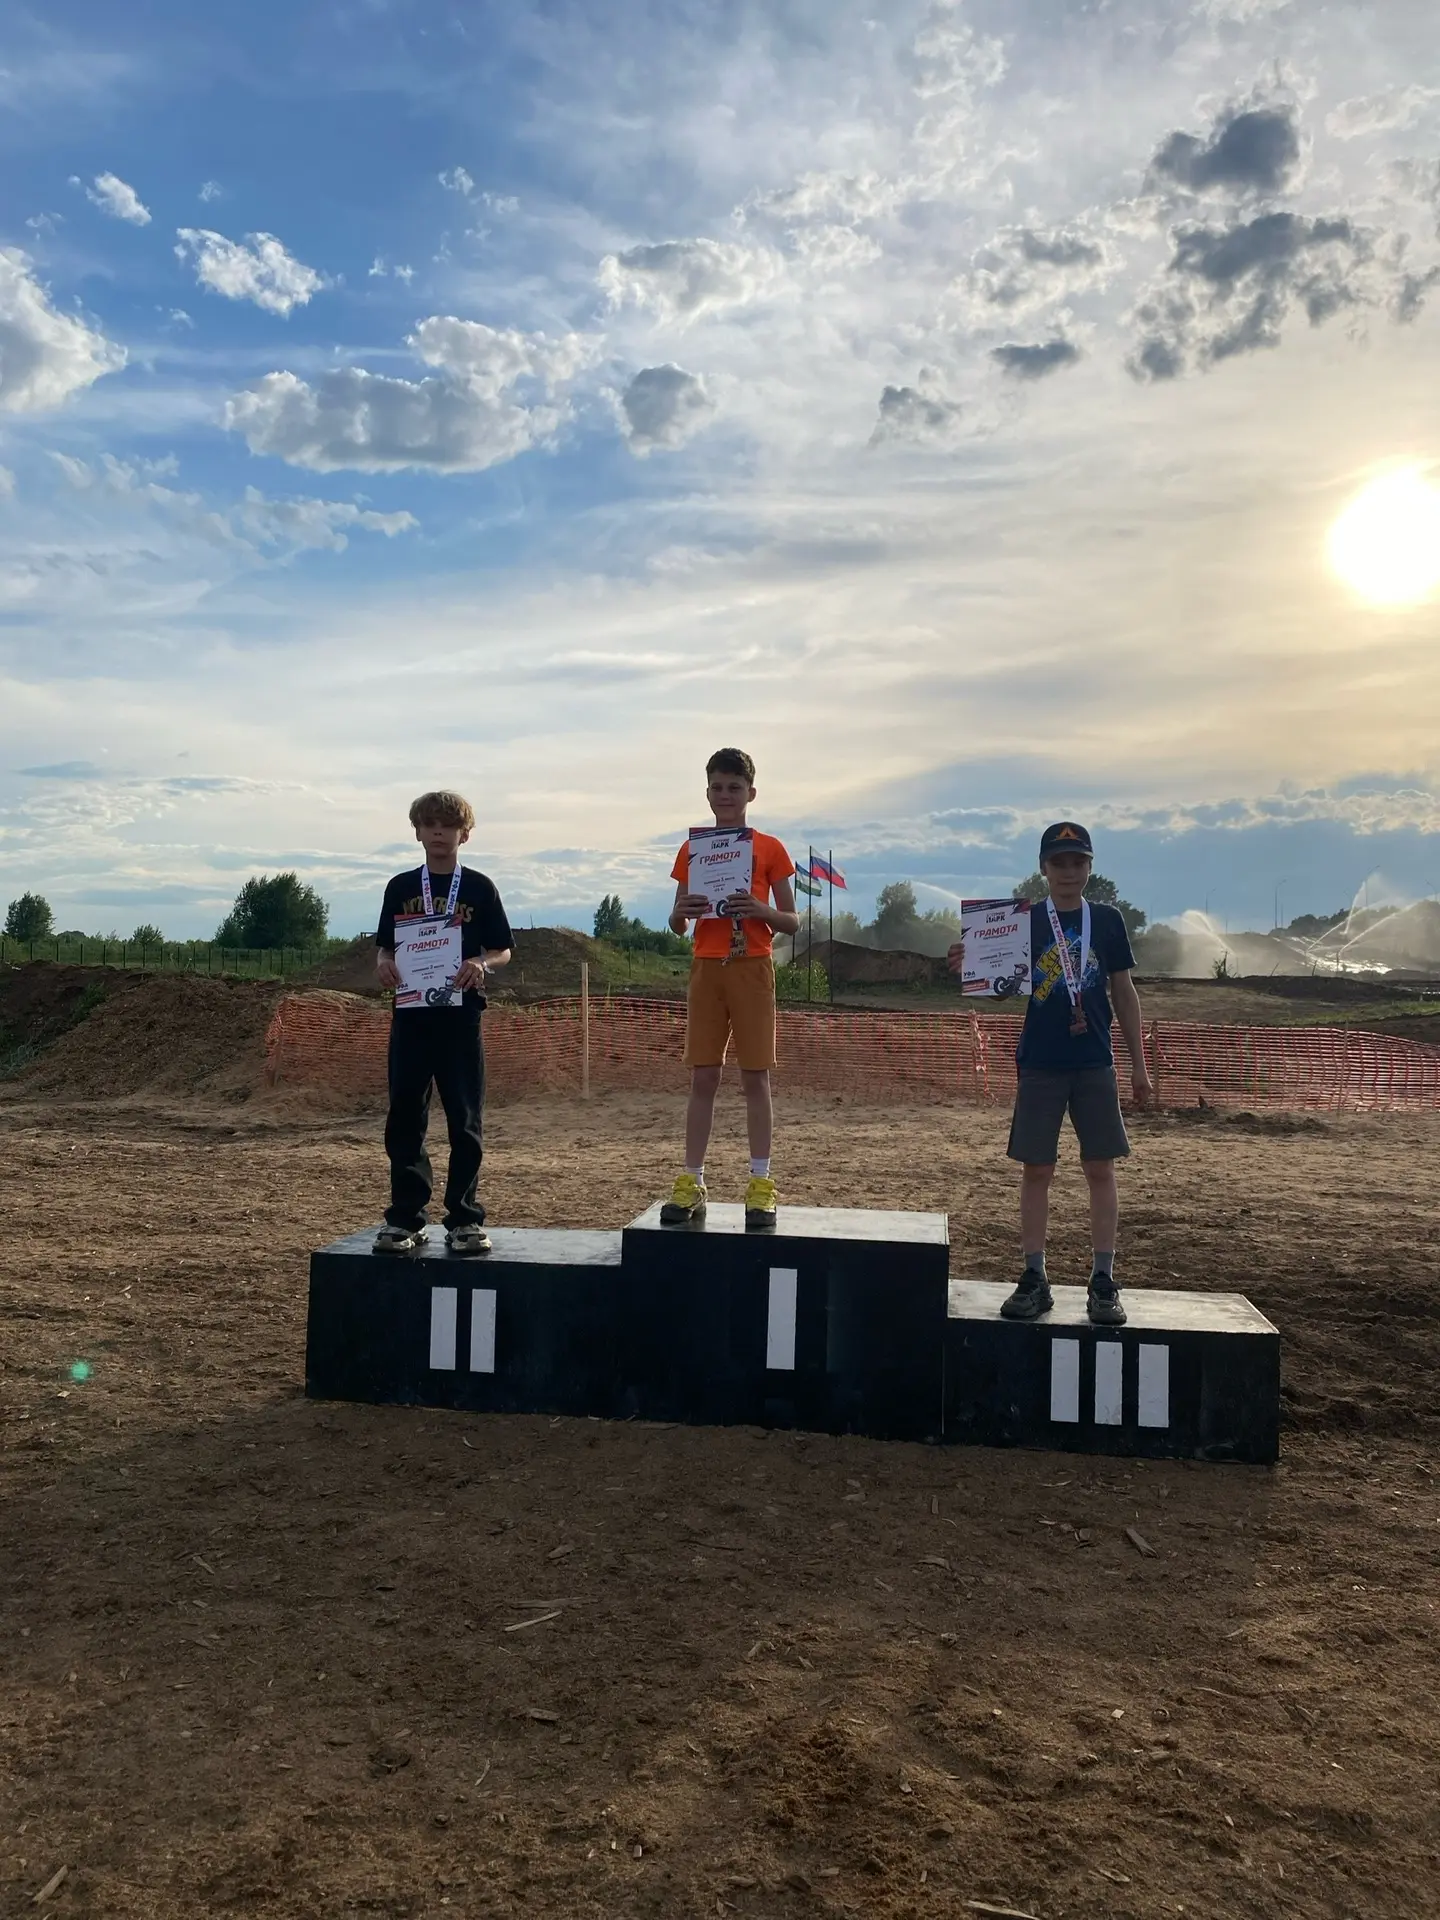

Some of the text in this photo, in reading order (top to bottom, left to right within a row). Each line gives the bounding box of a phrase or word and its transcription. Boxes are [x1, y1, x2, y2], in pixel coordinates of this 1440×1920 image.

[700, 851, 740, 865] ГРАМОТА
[974, 924, 1018, 939] ГРАМОТА
[406, 938, 450, 953] ГРАМОТА
